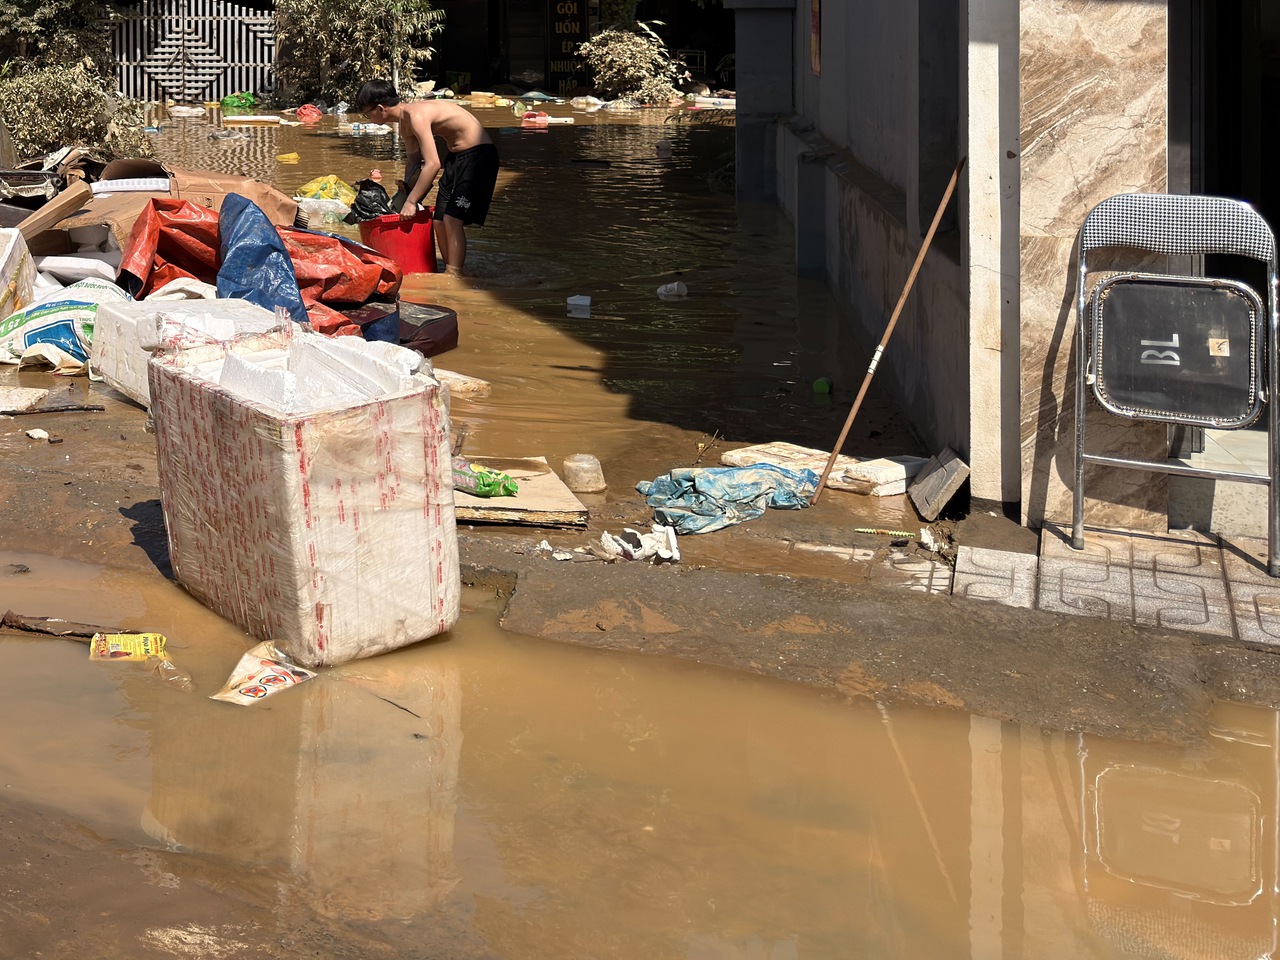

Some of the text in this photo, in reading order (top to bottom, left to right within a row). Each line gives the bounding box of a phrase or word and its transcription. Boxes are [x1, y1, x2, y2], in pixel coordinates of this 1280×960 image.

[556, 0, 578, 17] GỘI
[554, 18, 580, 34] UỐN
[561, 39, 574, 53] ÉP
[1140, 333, 1181, 366] BL
